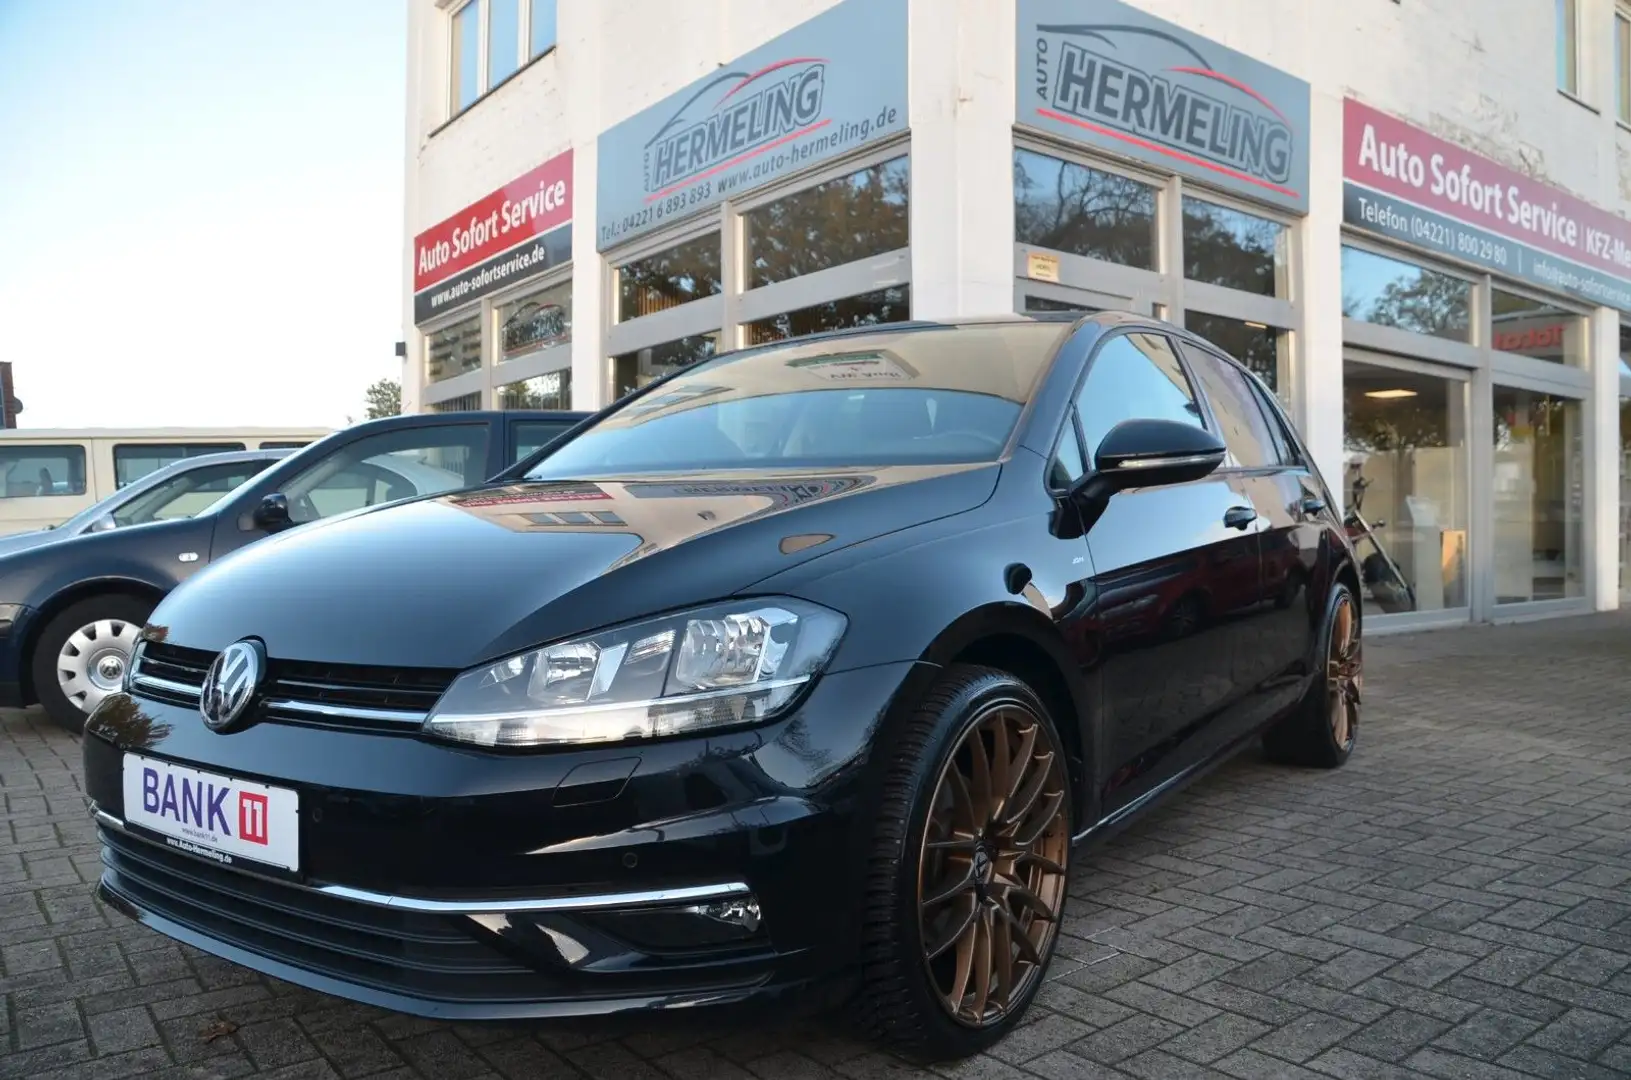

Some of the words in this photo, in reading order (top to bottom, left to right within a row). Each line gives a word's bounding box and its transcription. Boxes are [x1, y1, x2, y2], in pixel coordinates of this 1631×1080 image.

[1036, 37, 1048, 101] AUTO
[1056, 46, 1291, 179] HERMELING
[622, 206, 653, 233] 04221
[656, 201, 663, 219] 6
[665, 192, 686, 215] 893
[689, 181, 712, 205] 893
[717, 105, 897, 193] www.auto-hermeling.de
[654, 68, 822, 188] HERMELING
[418, 241, 450, 276] Auto
[452, 210, 498, 259] Sofort
[501, 179, 566, 234] Service
[1358, 123, 1424, 188] Auto
[1430, 153, 1503, 219] Sofort
[1507, 185, 1577, 247] Service
[1358, 197, 1408, 233] Telefon
[1410, 214, 1455, 251] (04221)
[431, 244, 545, 308] www.auto-sofortservice.de
[143, 767, 232, 837] BANK
[242, 798, 263, 838] 11
